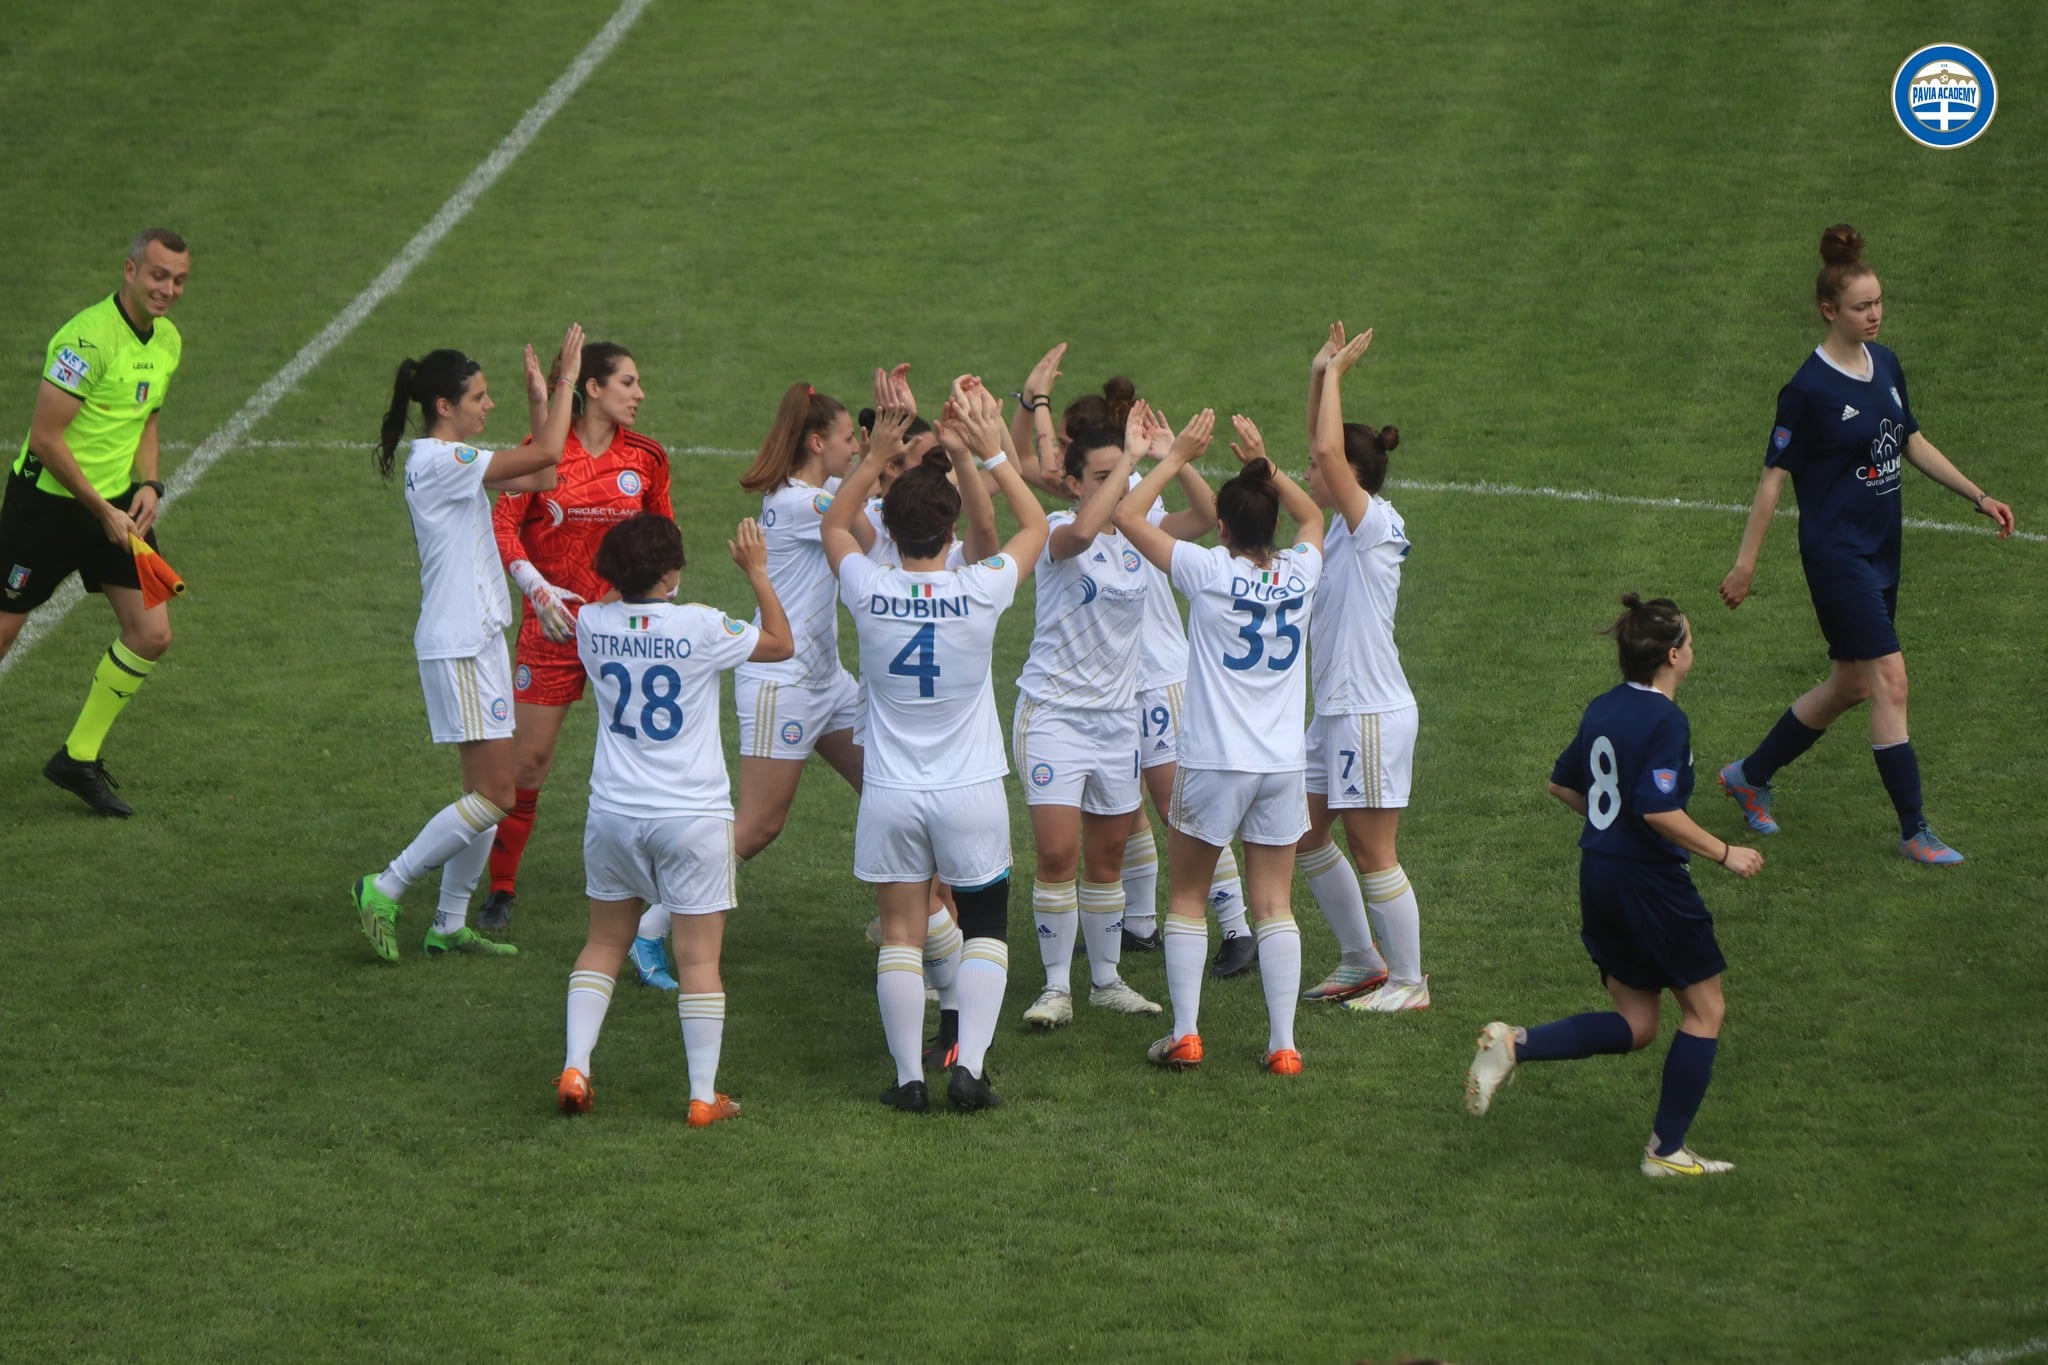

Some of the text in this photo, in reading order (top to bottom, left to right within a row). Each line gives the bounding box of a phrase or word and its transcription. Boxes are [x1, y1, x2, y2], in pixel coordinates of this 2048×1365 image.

[1231, 575, 1306, 602] D'UGO
[870, 593, 969, 618] DUBINI
[591, 633, 692, 659] STRANIERO
[1222, 594, 1304, 671] 35
[888, 622, 941, 698] 4
[600, 661, 683, 742] 28
[1142, 706, 1170, 738] 19
[1339, 750, 1356, 780] 7
[1588, 735, 1622, 831] 8
